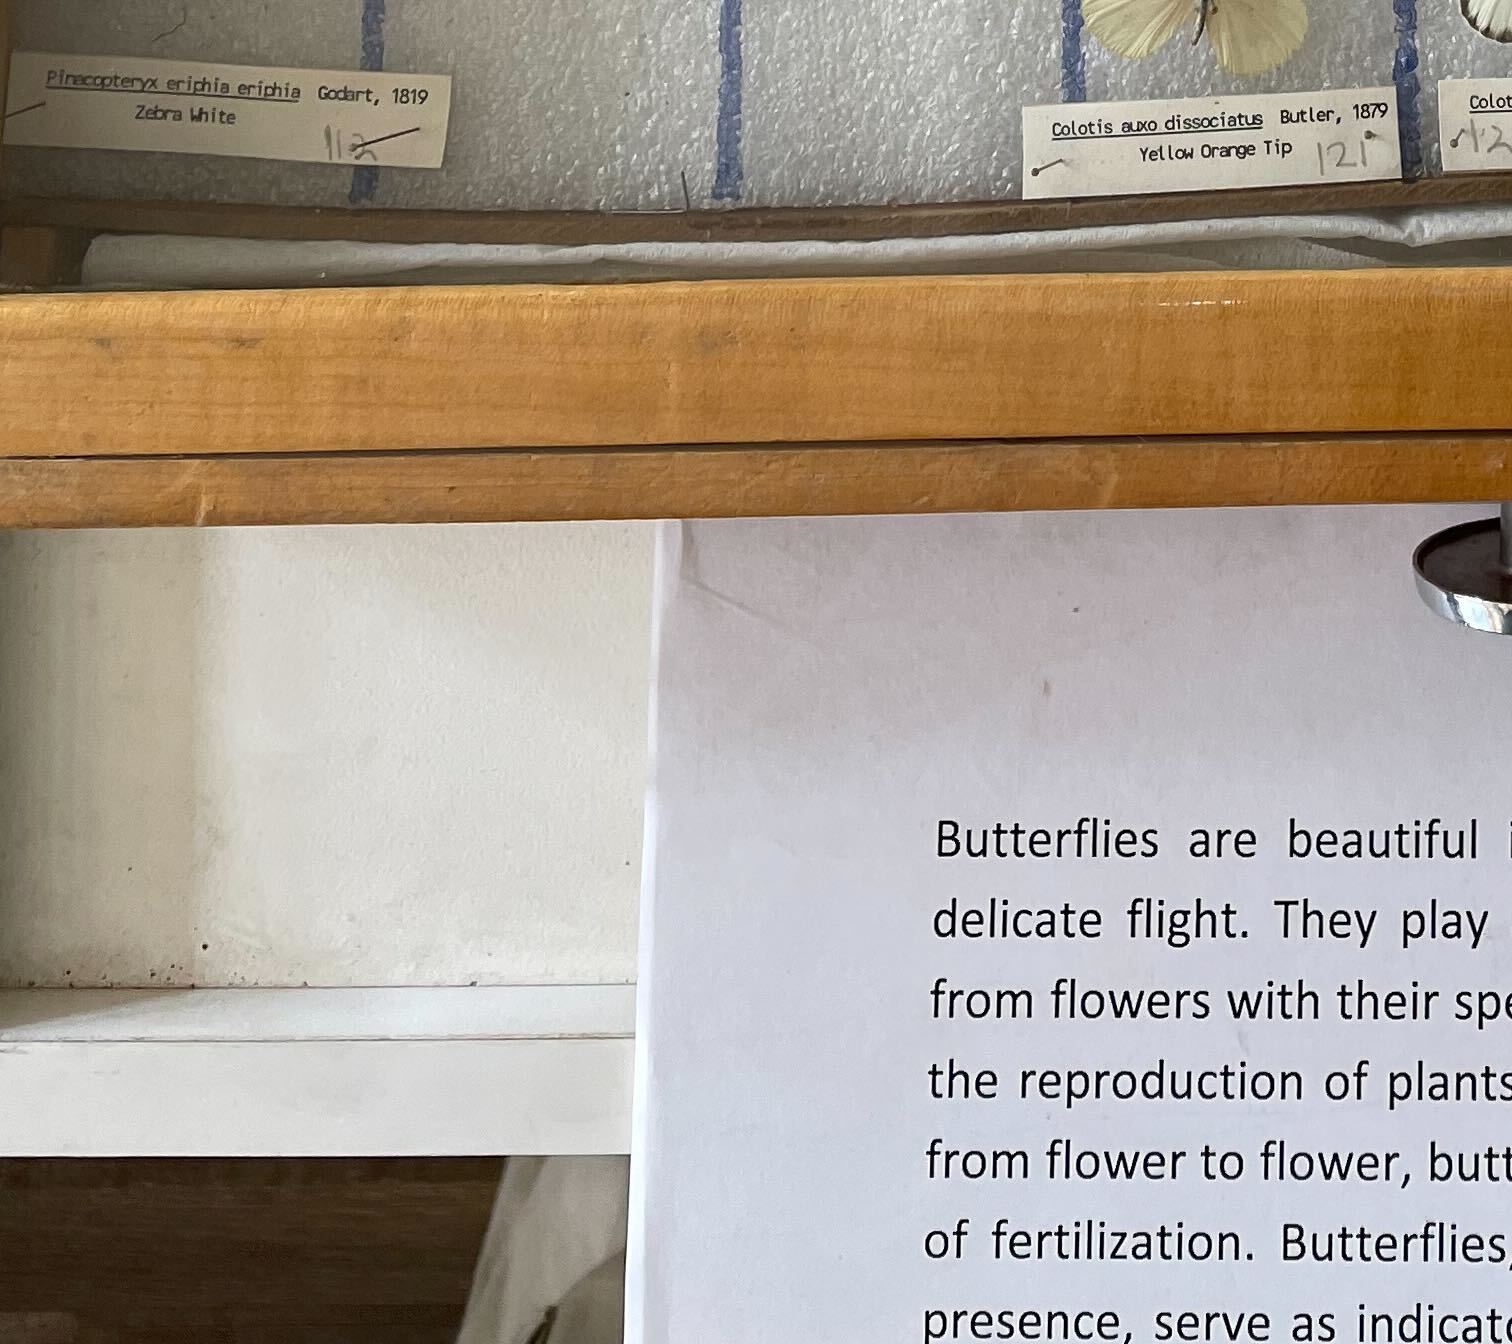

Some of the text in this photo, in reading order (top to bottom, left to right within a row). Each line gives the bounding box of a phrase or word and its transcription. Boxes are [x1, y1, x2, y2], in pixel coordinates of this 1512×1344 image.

[135, 105, 236, 124] Zebra White
[1052, 103, 1388, 137] Colotis auxo dissociatus Butler, 1879
[1140, 139, 1292, 162] Yellow Orange Tip
[938, 817, 1158, 857] Butterflies
[1190, 829, 1256, 857] are
[1289, 818, 1476, 859] beautiful
[928, 1058, 997, 1098] the
[1021, 1059, 1302, 1108] reproduction
[1326, 1060, 1369, 1100] of
